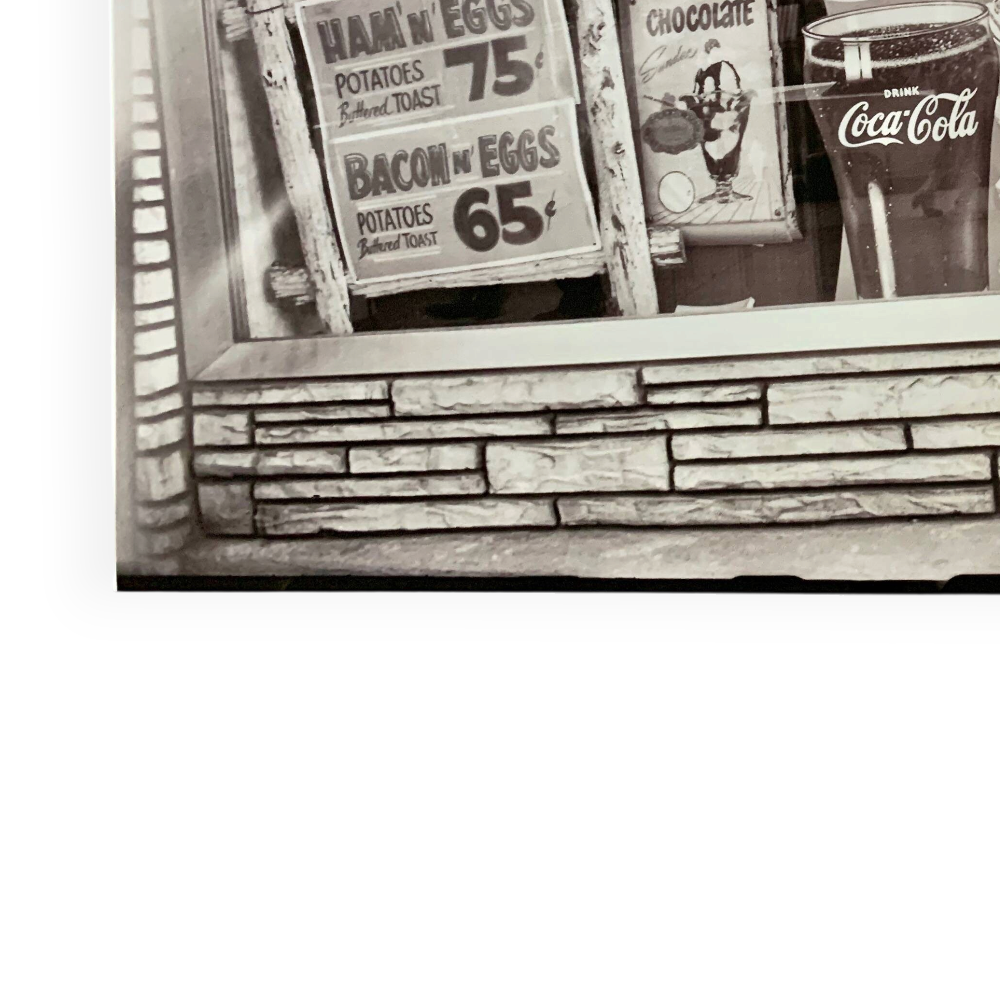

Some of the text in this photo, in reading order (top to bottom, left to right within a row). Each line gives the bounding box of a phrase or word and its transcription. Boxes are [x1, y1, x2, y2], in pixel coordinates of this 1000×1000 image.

[335, 60, 424, 98] POTATOES
[884, 86, 920, 98] DRINK
[337, 84, 441, 128] Buttered TOAST
[838, 87, 979, 147] Coca-Cola
[344, 143, 451, 200] BACON
[478, 125, 560, 178] EGGS
[357, 203, 433, 235] POTATOES
[357, 231, 438, 259] Buttered TOAST
